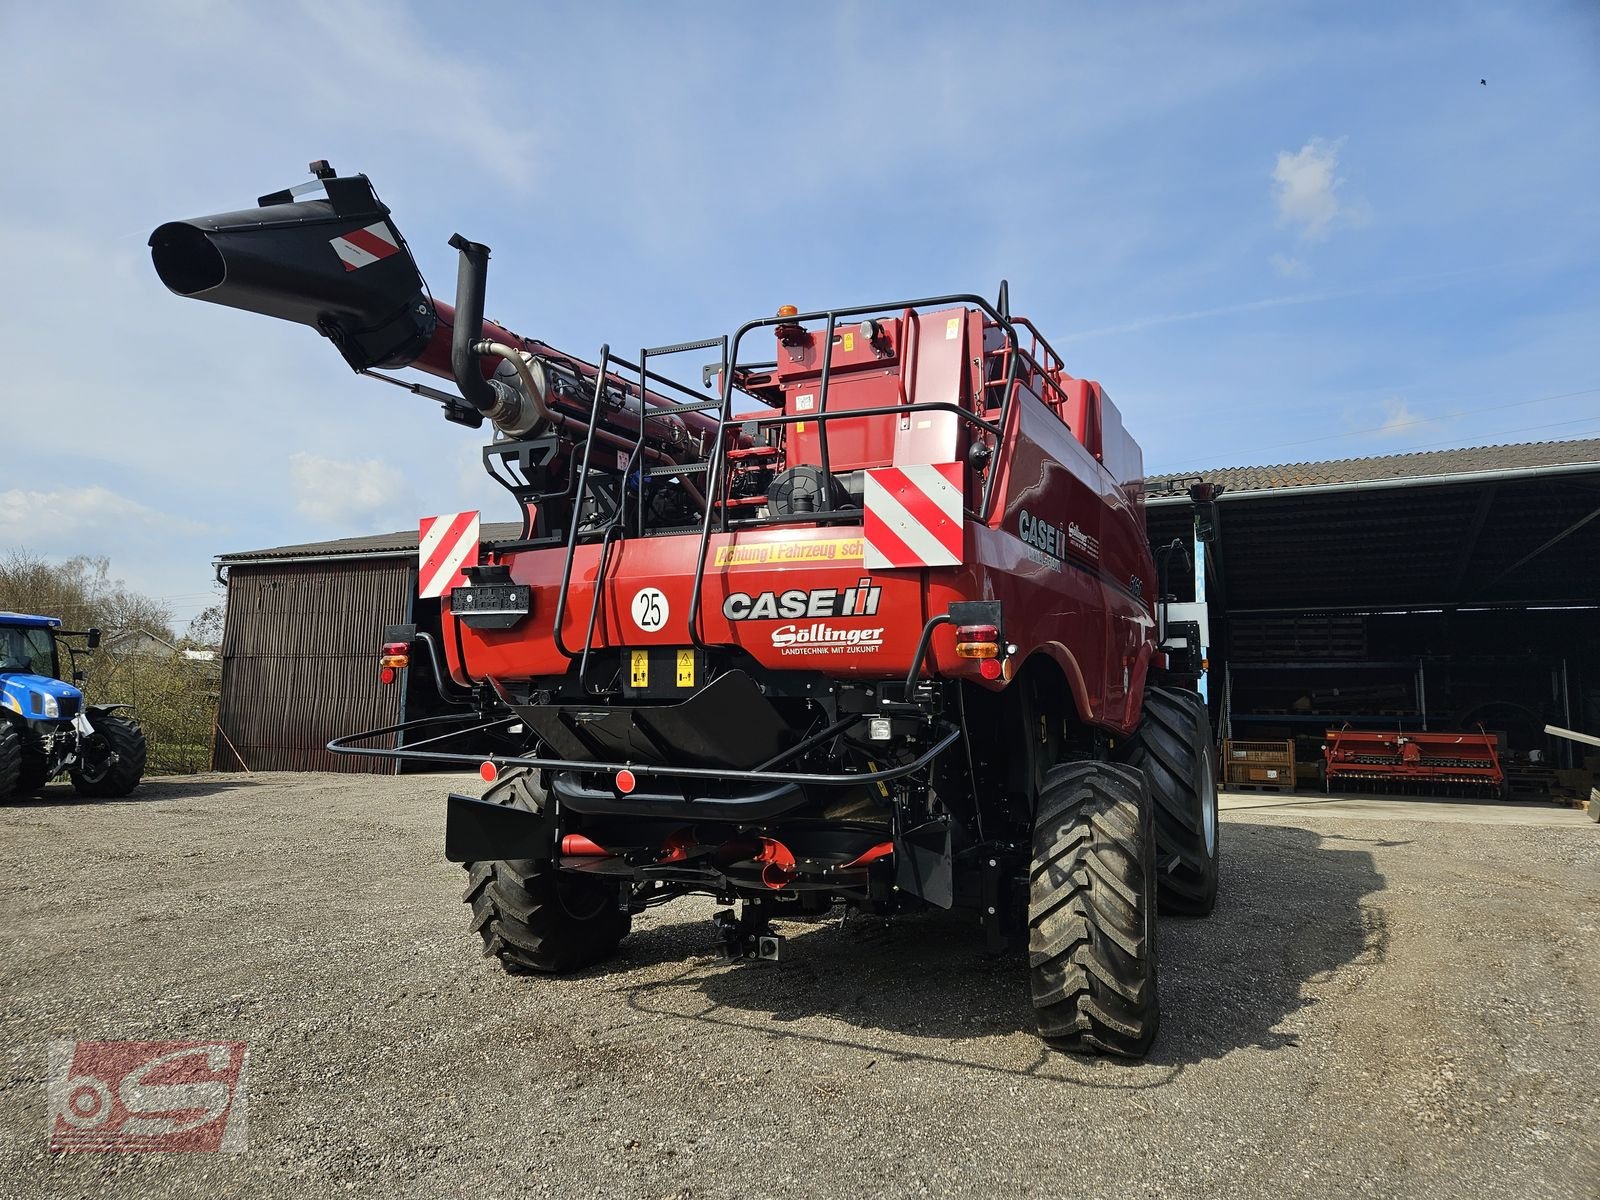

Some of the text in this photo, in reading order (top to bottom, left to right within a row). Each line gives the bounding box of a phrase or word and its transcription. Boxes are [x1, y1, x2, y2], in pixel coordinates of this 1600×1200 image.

[1019, 509, 1055, 555] CASE
[717, 544, 774, 563] Achtung!
[777, 543, 837, 560] Fahrzeug
[640, 593, 661, 626] 25
[723, 589, 837, 620] CASE
[771, 623, 884, 647] Söllinger
[781, 647, 829, 655] LANDTECHNIK
[846, 645, 880, 653] ZUKUNFT
